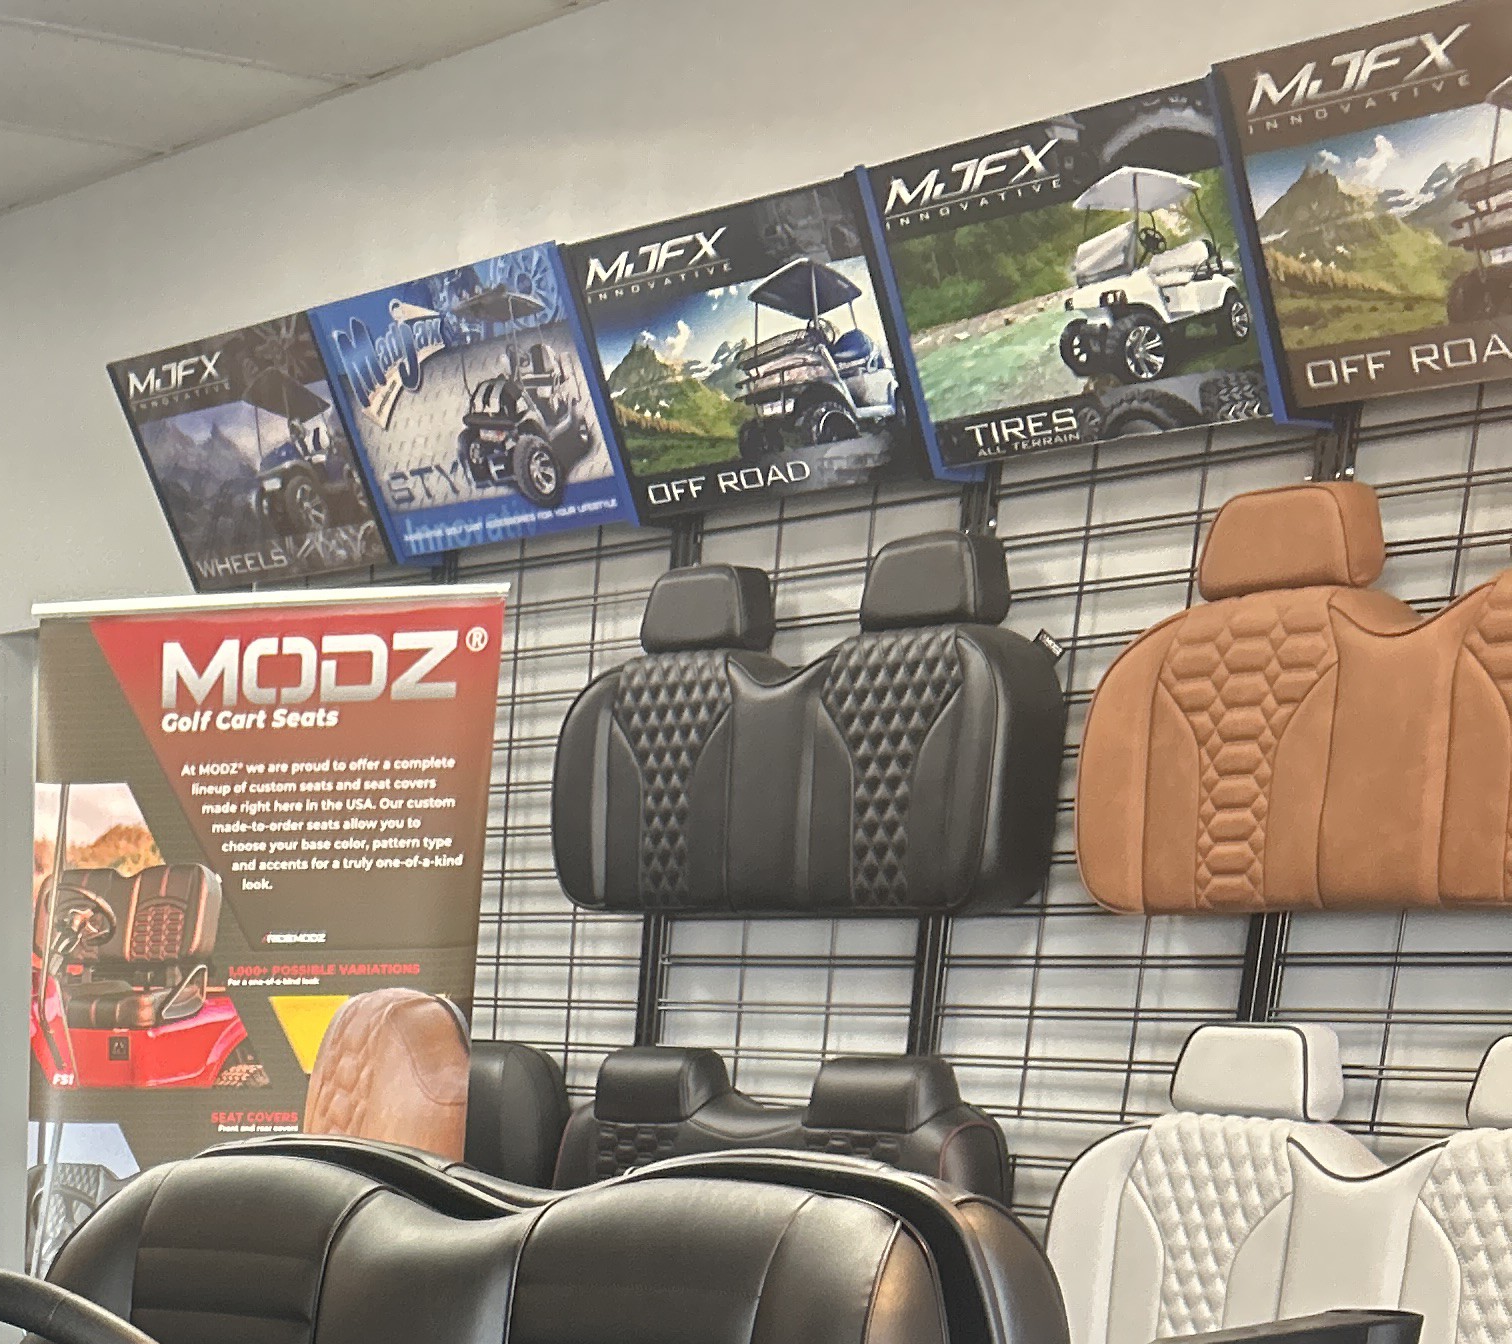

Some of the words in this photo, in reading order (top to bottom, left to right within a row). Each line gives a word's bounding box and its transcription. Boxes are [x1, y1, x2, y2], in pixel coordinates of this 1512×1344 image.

[1247, 24, 1471, 115] MJFX
[1248, 75, 1471, 135] INNOVATIVE
[884, 139, 1058, 216] MJFX
[886, 178, 1062, 229] INNOVATIVE
[587, 227, 727, 289] MJFX
[588, 262, 732, 303] INNOVATIVE
[128, 352, 223, 399] MJFX
[1307, 350, 1391, 390] OFF
[1410, 333, 1512, 374] ROA
[965, 407, 1078, 447] TIRES
[979, 445, 1006, 457] ALL
[1012, 432, 1080, 451] TERRAIN
[648, 477, 705, 505] OFF
[718, 460, 811, 492] ROAD
[196, 549, 288, 579] WHEELS
[162, 709, 212, 734] Golf
[216, 708, 266, 732] Cart
[273, 706, 339, 730] Seats
[181, 765, 196, 777] At
[246, 763, 265, 774] we
[268, 763, 288, 774] are
[291, 759, 330, 775] proud
[333, 760, 346, 772] to
[349, 758, 380, 771] offer
[383, 761, 390, 770] a
[393, 756, 456, 771] complete
[191, 781, 231, 796] lineup
[233, 781, 247, 793] of
[249, 781, 297, 793] custom
[300, 779, 333, 792] seats
[336, 778, 361, 791] and
[364, 778, 390, 790] seat
[393, 778, 437, 790] covers
[202, 801, 237, 814] made
[240, 800, 271, 816] right
[274, 799, 302, 812] here
[305, 799, 318, 811] in
[321, 799, 343, 811] the
[346, 798, 377, 811] USA.
[379, 797, 404, 810] Our
[406, 797, 456, 809] custom
[212, 820, 304, 833] made-to-order
[306, 819, 340, 831] seats
[343, 817, 378, 830] allow
[380, 819, 404, 832] you
[407, 818, 421, 829] to
[221, 840, 267, 852] choose
[269, 841, 299, 854] your
[301, 838, 331, 850] base
[333, 837, 370, 852] color,
[372, 838, 420, 852] pattern
[423, 836, 453, 850] type
[231, 859, 256, 872] and
[258, 859, 308, 871] accents
[311, 857, 330, 870] for
[332, 860, 340, 869] a
[343, 857, 373, 872] truly
[376, 854, 463, 868] one-of-a-kind
[242, 878, 273, 891] look.
[271, 963, 336, 976] POSSIBLE
[339, 963, 420, 975] VARIATIONS
[211, 1111, 244, 1123] SEAT
[247, 1111, 298, 1123] COVERS
